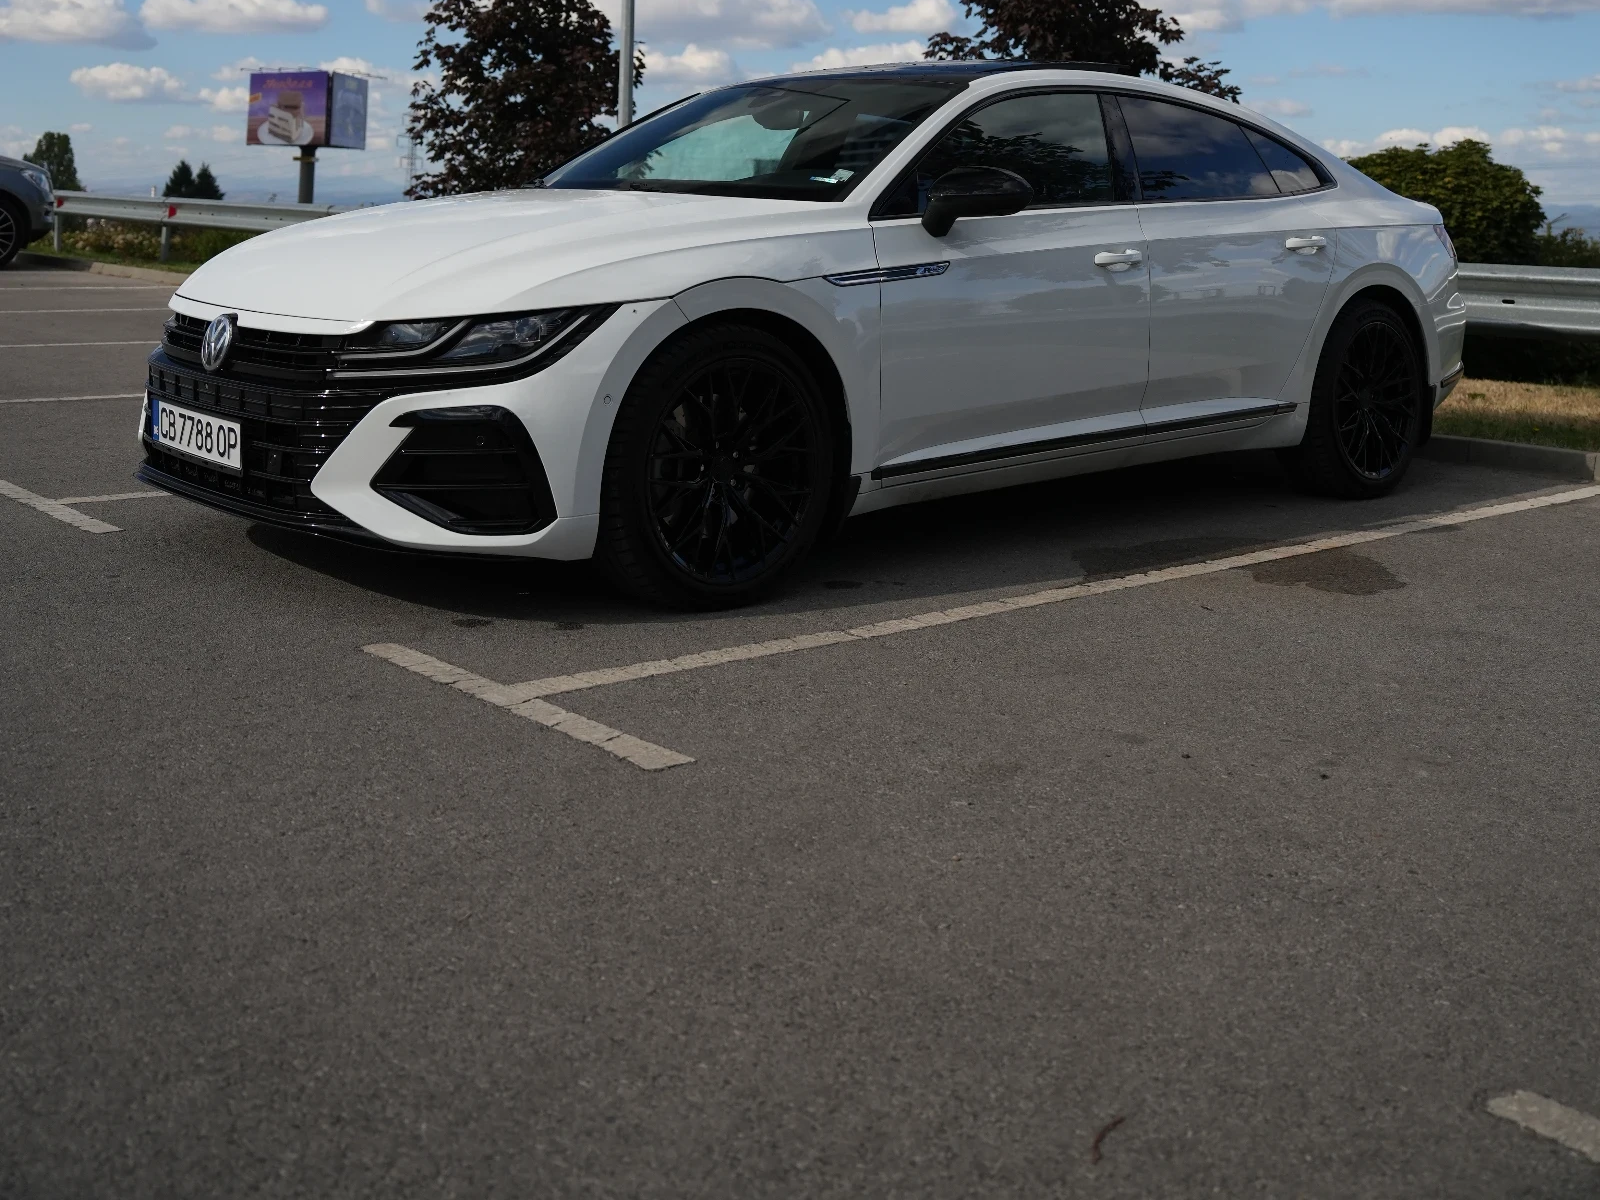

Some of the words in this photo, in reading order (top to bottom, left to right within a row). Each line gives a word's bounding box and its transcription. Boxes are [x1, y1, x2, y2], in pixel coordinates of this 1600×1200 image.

[160, 406, 176, 442] CB
[178, 412, 213, 454] 7788
[216, 424, 238, 460] OP
